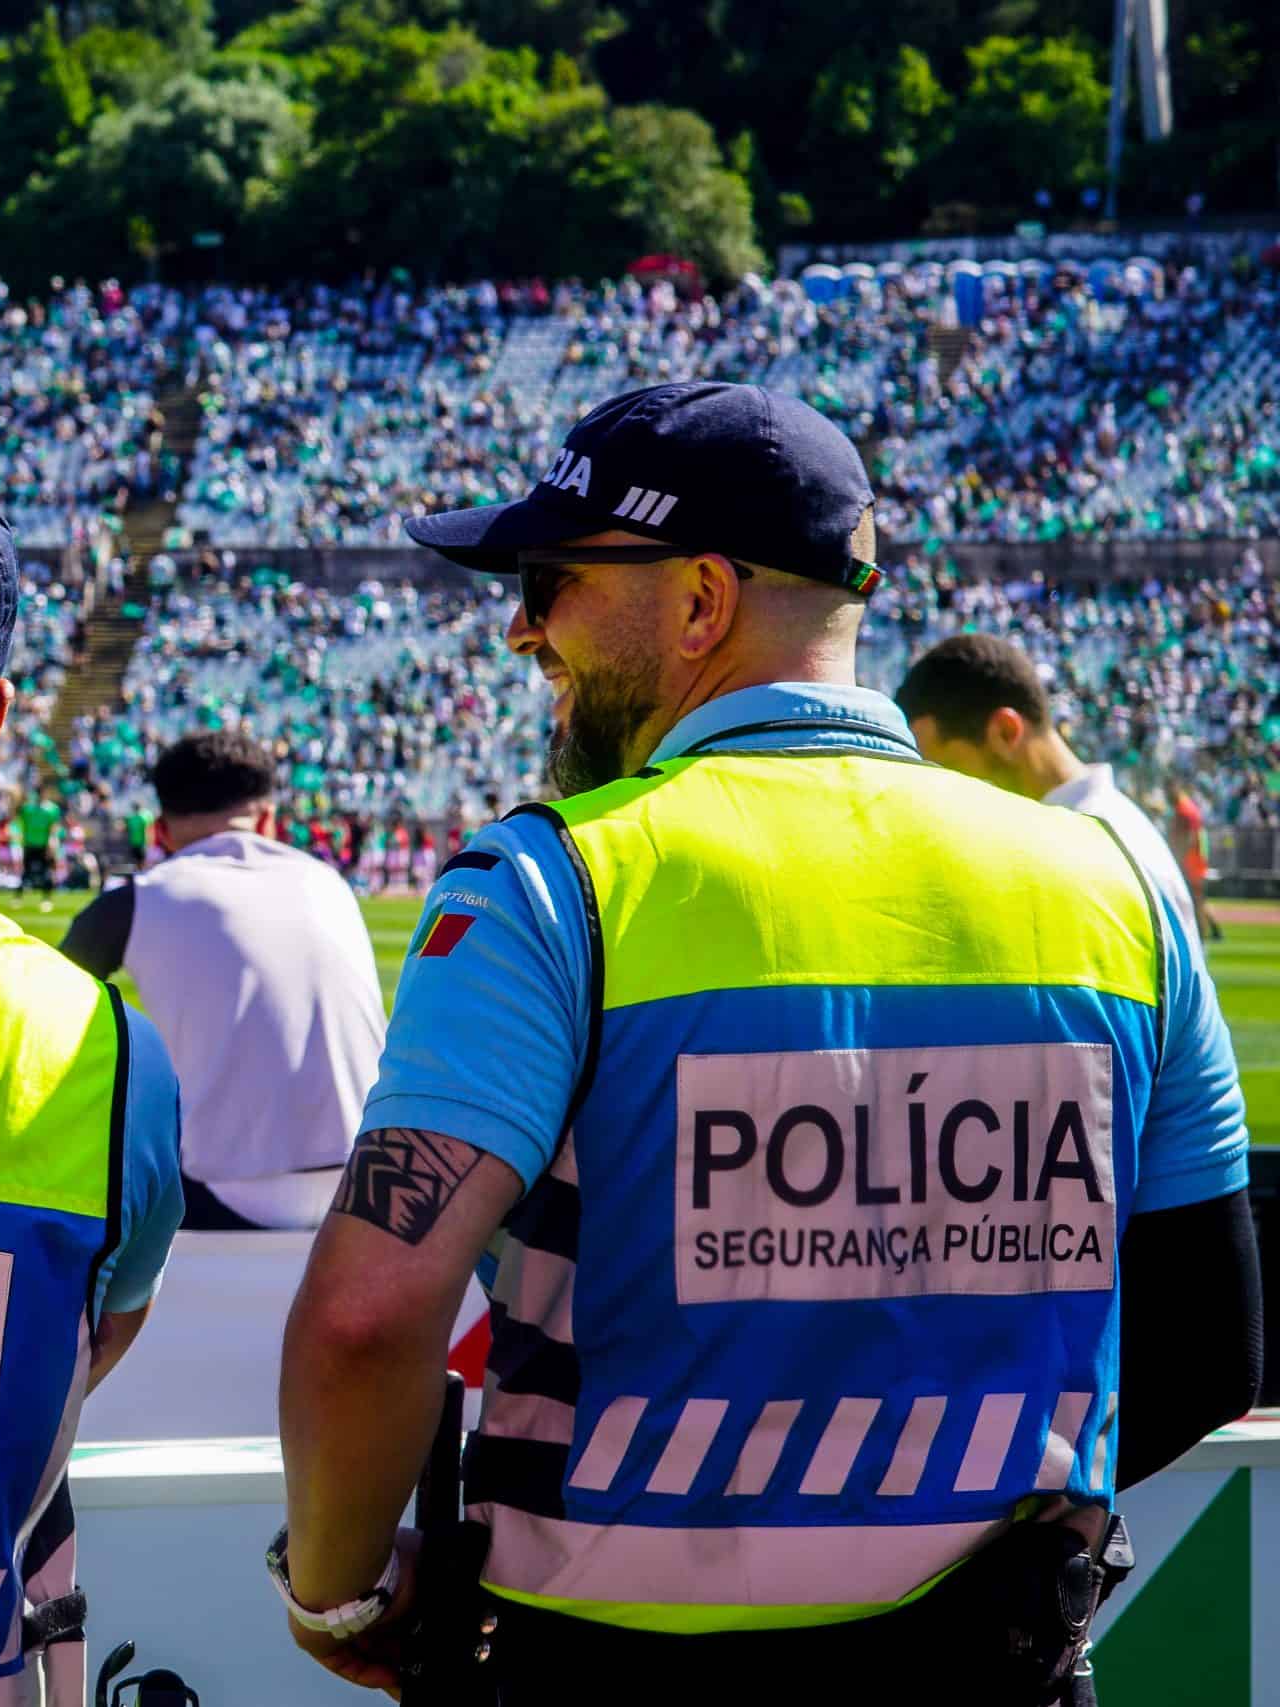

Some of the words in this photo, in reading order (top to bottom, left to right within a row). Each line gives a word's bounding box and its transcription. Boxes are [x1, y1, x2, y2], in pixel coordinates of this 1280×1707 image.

[692, 1072, 1105, 1209] POLÍCIA
[695, 1226, 932, 1275] SEGURANÇA
[943, 1214, 1103, 1263] PÚBLICA
